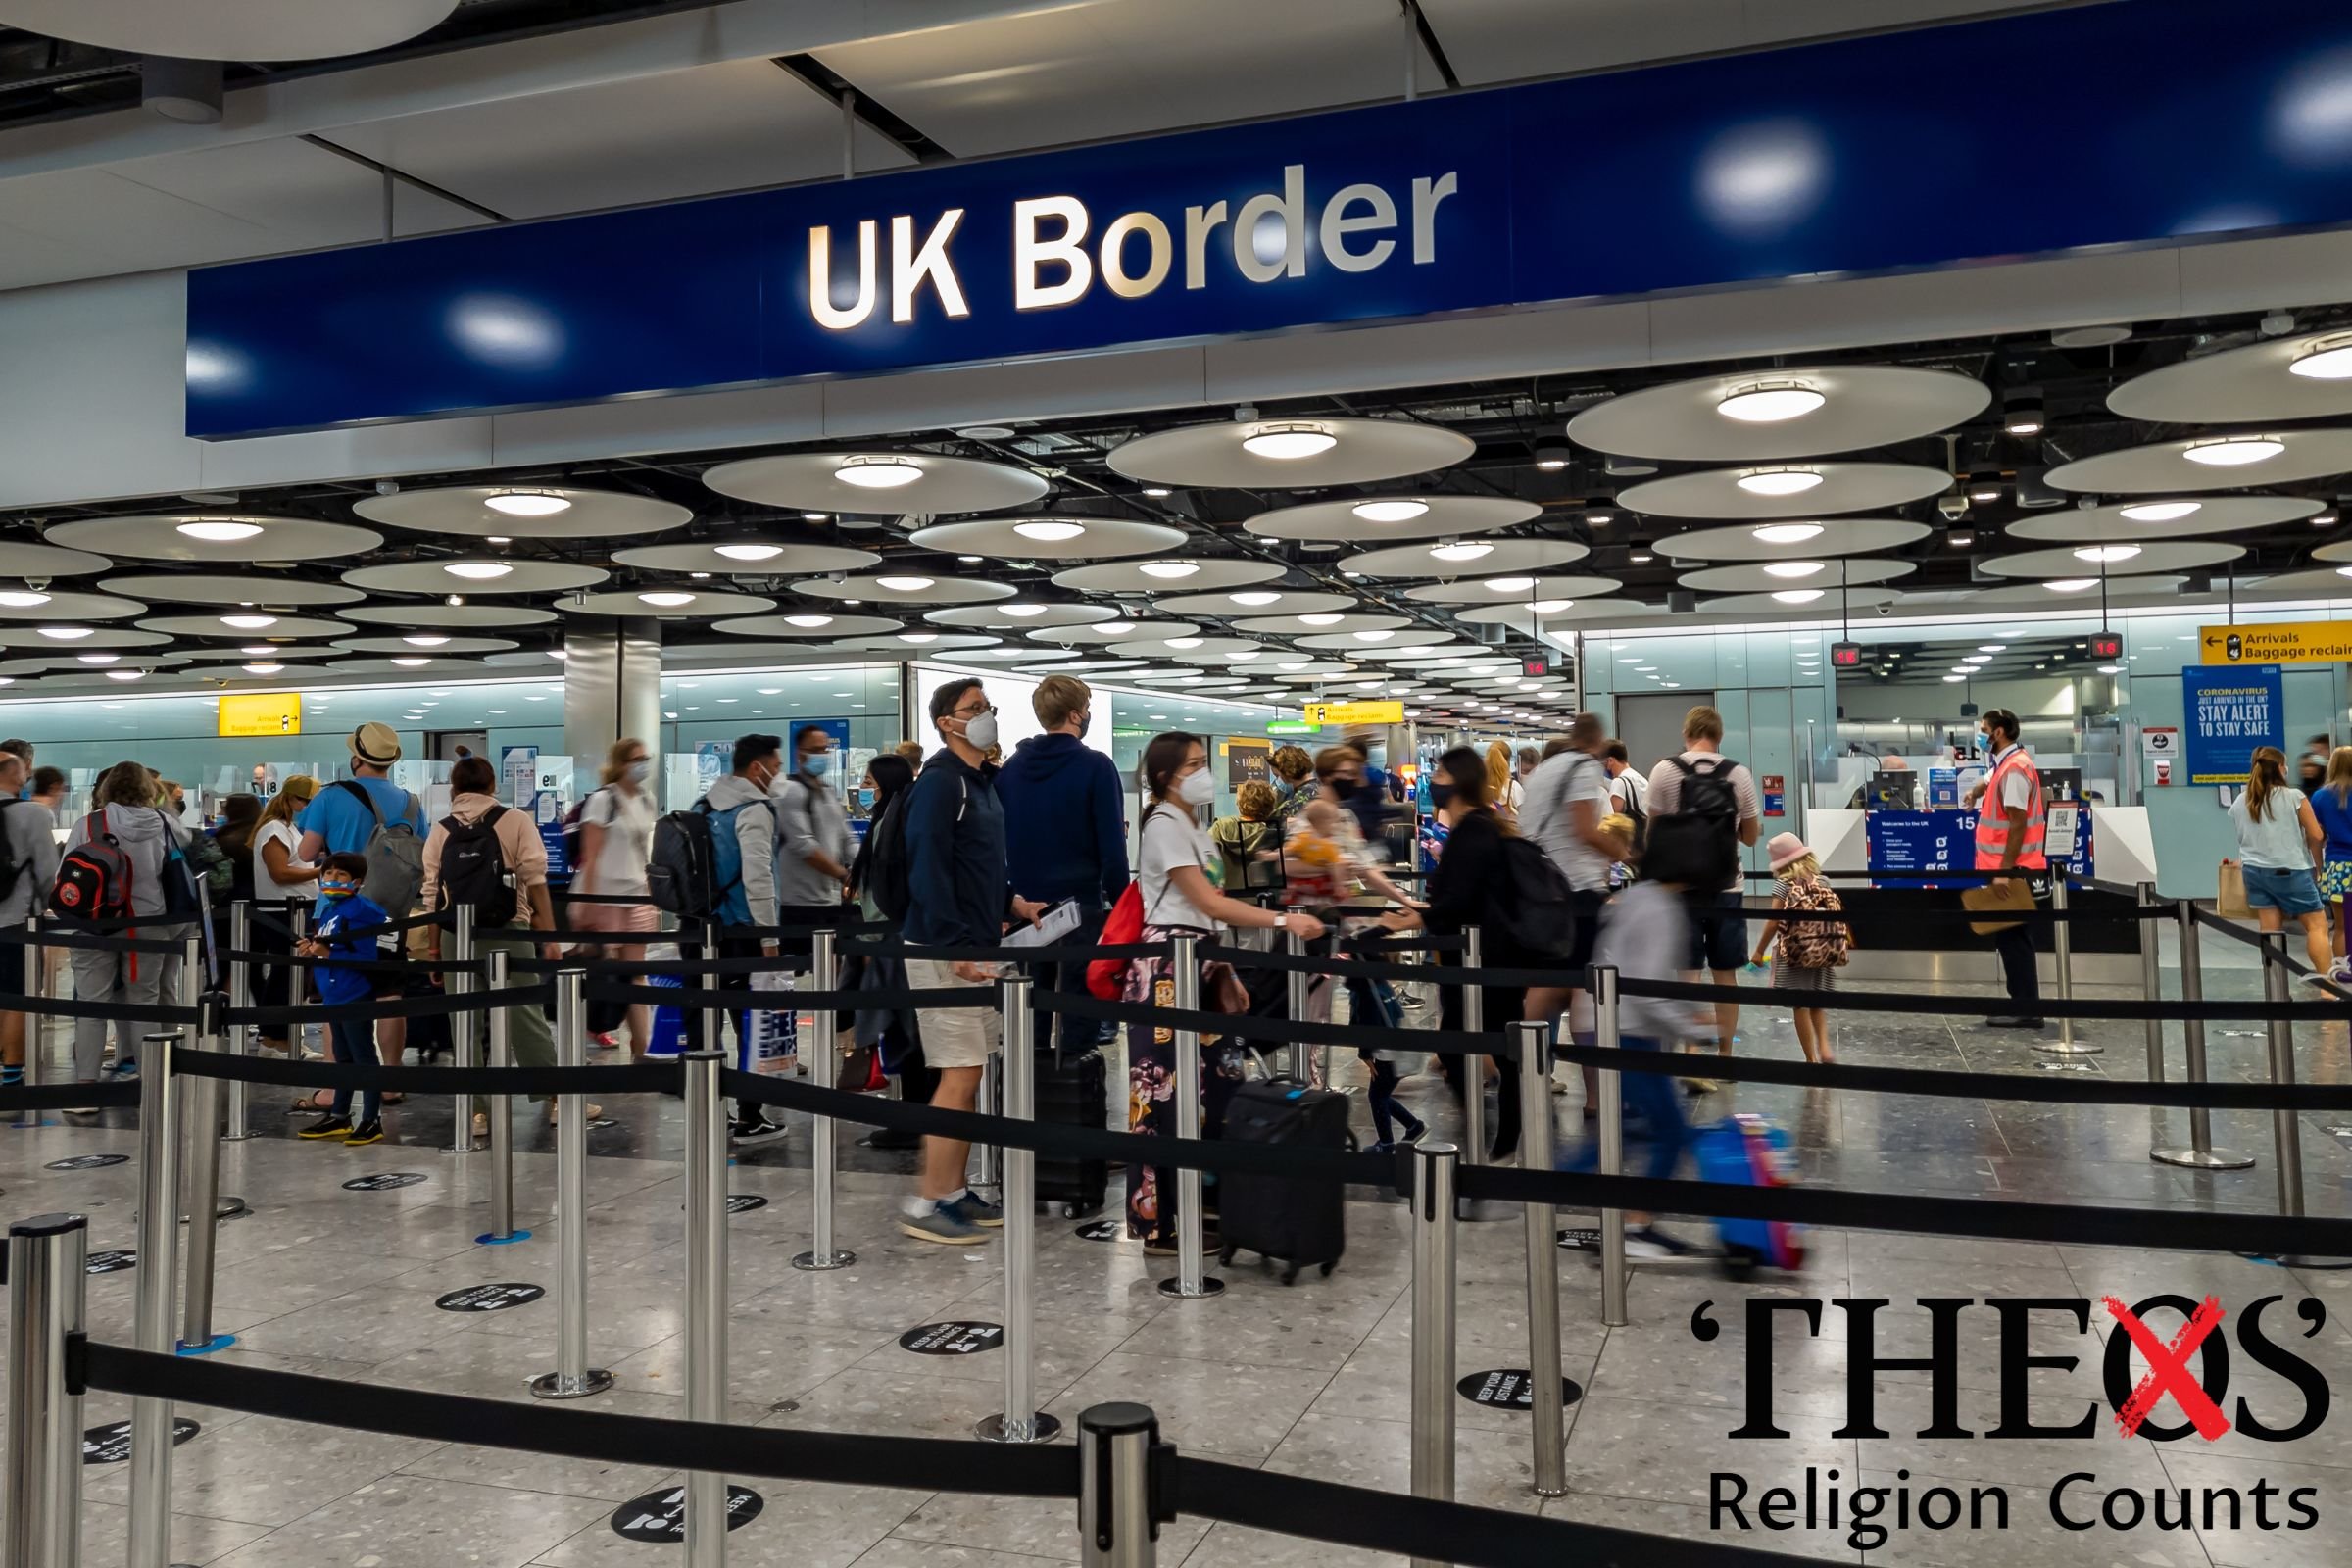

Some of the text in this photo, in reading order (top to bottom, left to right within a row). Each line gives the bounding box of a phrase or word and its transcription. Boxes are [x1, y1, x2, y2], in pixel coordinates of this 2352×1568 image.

[808, 164, 1458, 330] UK Border
[2245, 632, 2299, 644] Arrivals
[2245, 646, 2306, 660] Baggage
[2197, 687, 2268, 697] CORONAVIRUS
[2198, 696, 2212, 705] JUST
[2213, 696, 2237, 705] ARRIVED
[2257, 695, 2269, 704] UK?
[2198, 704, 2269, 722] STAY ALERT
[2199, 721, 2271, 737] TO STAY SAFE
[1956, 816, 1976, 830] 15
[908, 1336, 932, 1348] KEEP
[925, 1326, 966, 1348] DISTANCE
[1476, 1372, 1504, 1401] KEEP YOUR
[1494, 1375, 1520, 1401] DISTANCE
